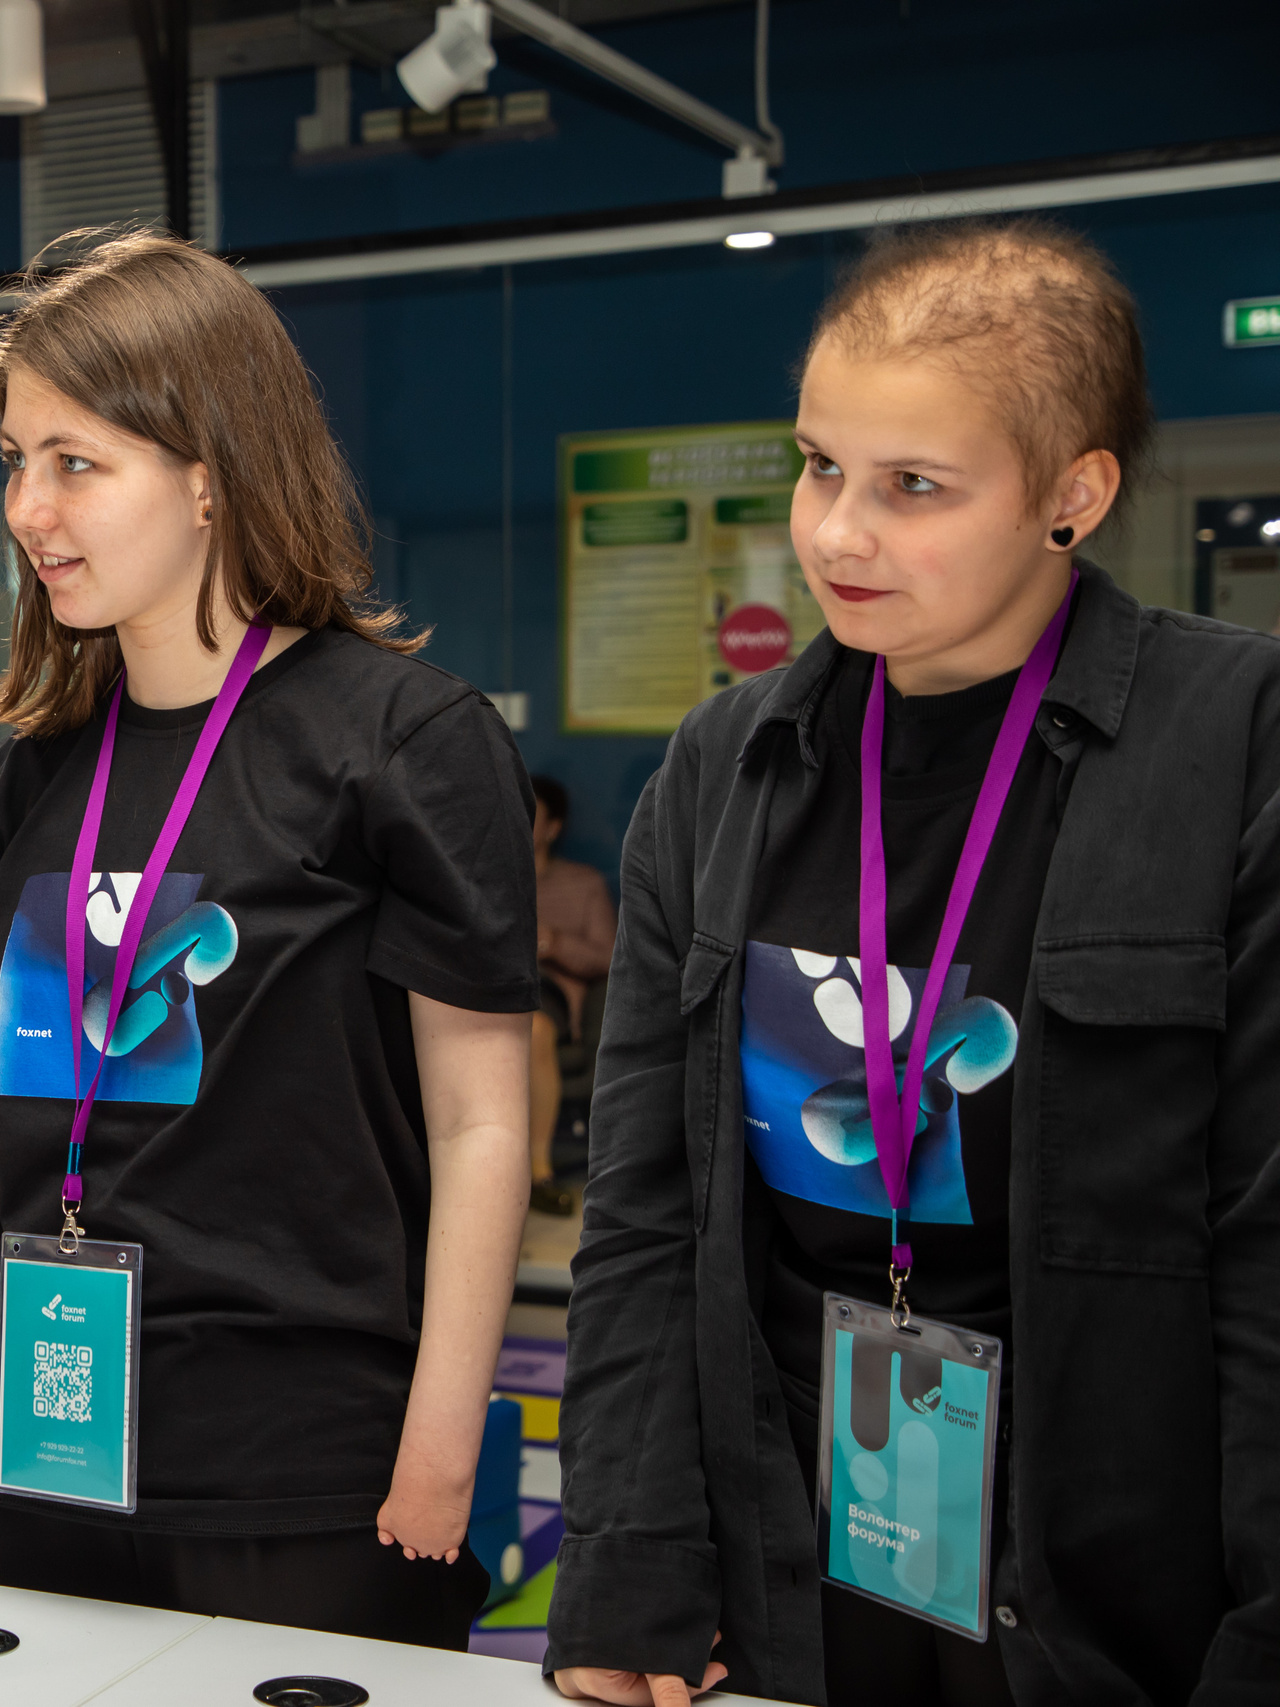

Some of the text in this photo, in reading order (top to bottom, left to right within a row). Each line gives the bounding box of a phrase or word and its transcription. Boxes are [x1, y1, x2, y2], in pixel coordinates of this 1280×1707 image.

[16, 1027, 53, 1038] foxnet
[61, 1304, 87, 1316] foxnet
[61, 1313, 85, 1323] forum
[943, 1411, 977, 1431] forum
[944, 1401, 979, 1421] foxnet
[848, 1503, 921, 1542] Волонтер
[847, 1522, 905, 1554] форума
